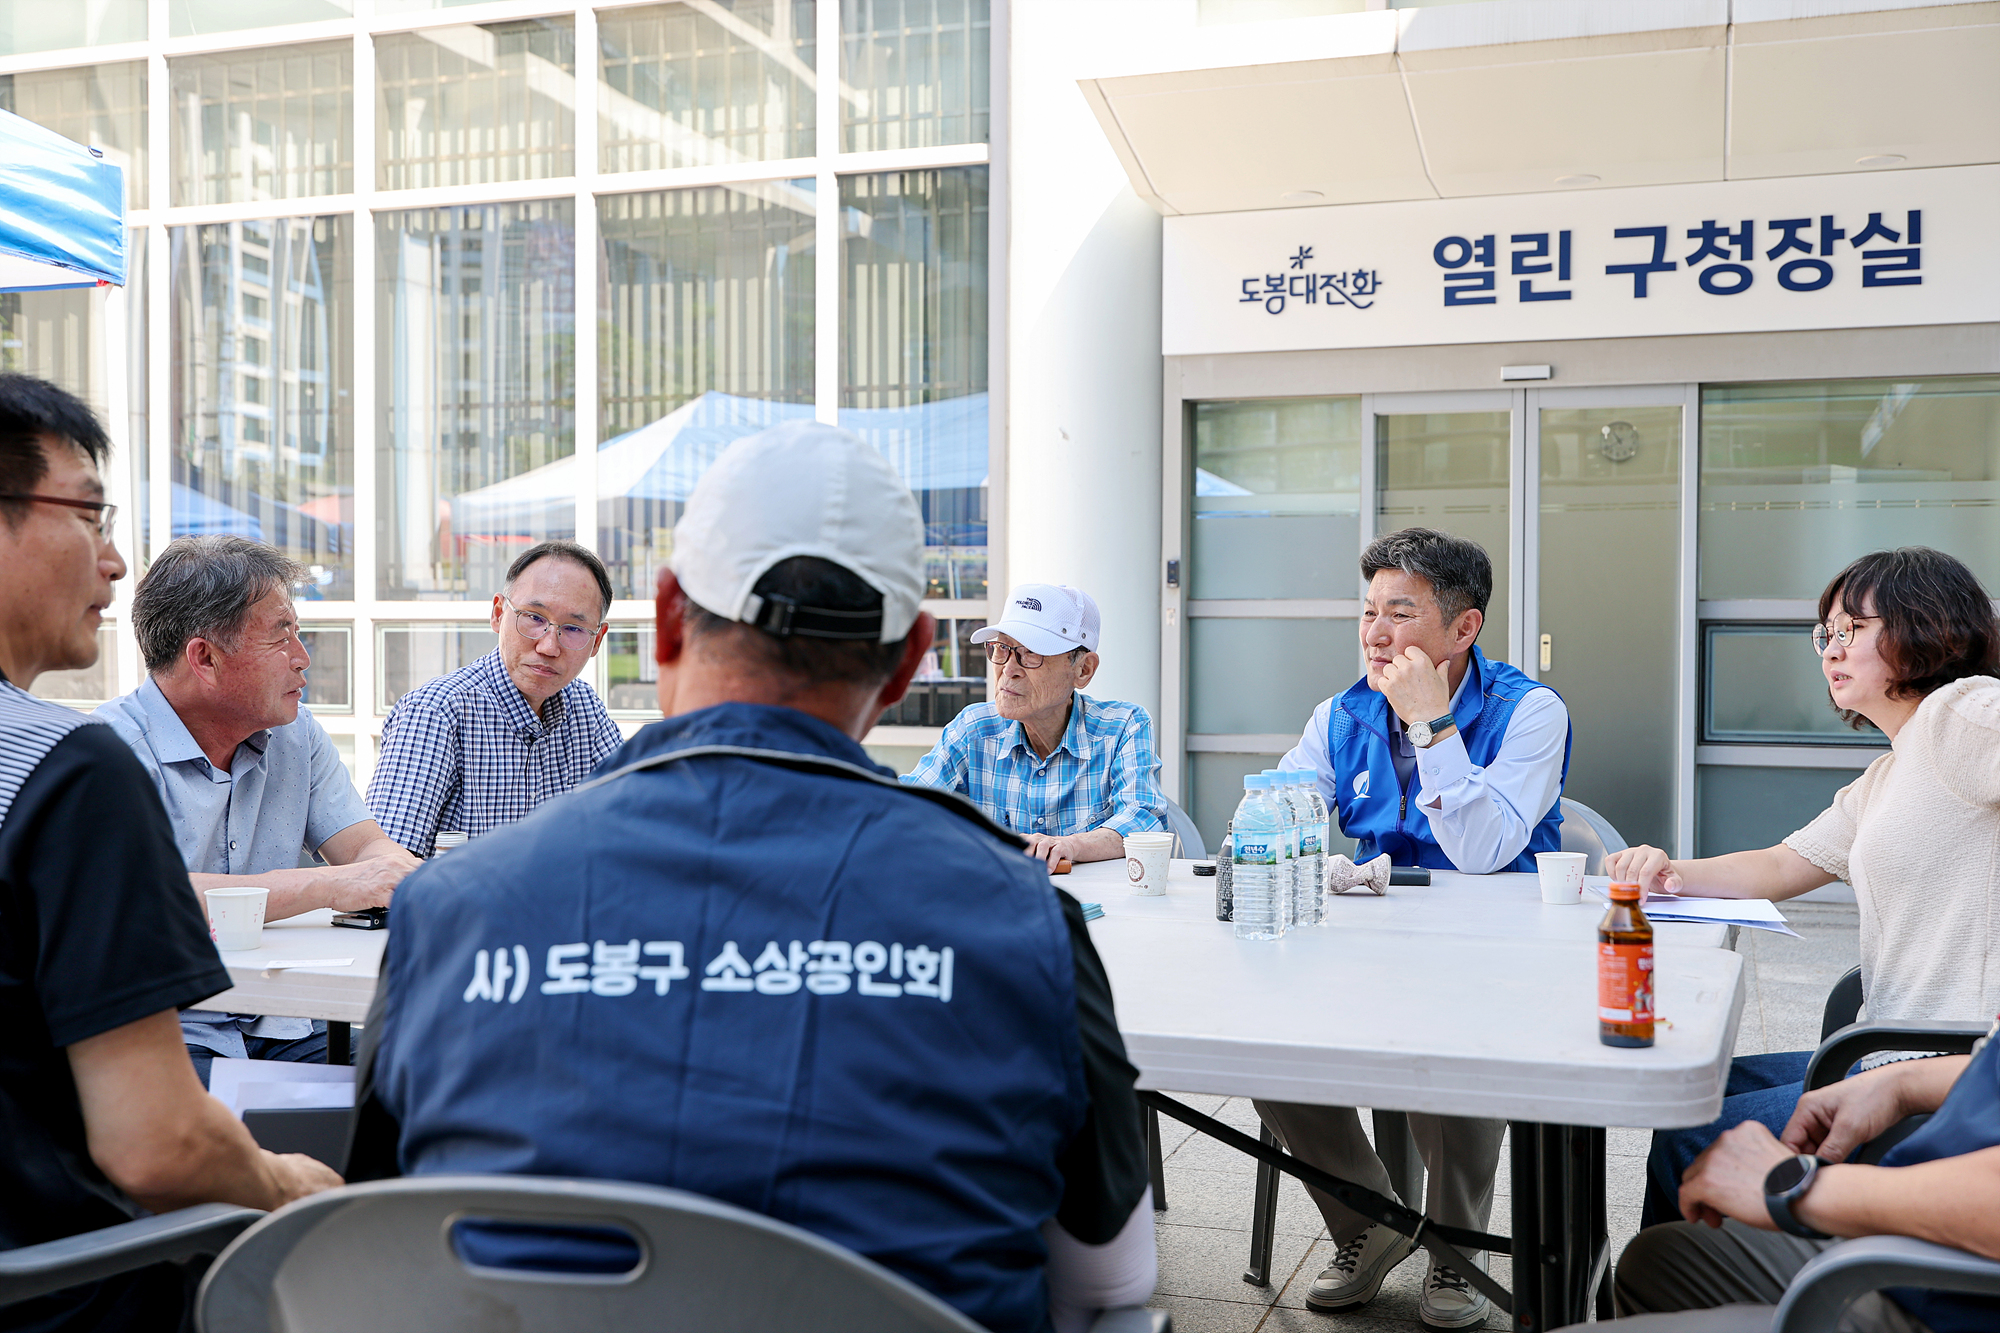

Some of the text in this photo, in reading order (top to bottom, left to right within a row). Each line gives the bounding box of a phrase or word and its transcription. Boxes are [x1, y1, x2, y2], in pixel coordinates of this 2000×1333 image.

[1433, 209, 1923, 307] 열린 구청장실
[1239, 269, 1382, 315] 도봉대전환
[463, 939, 954, 1003] 사) 도봉구 소상공인회
